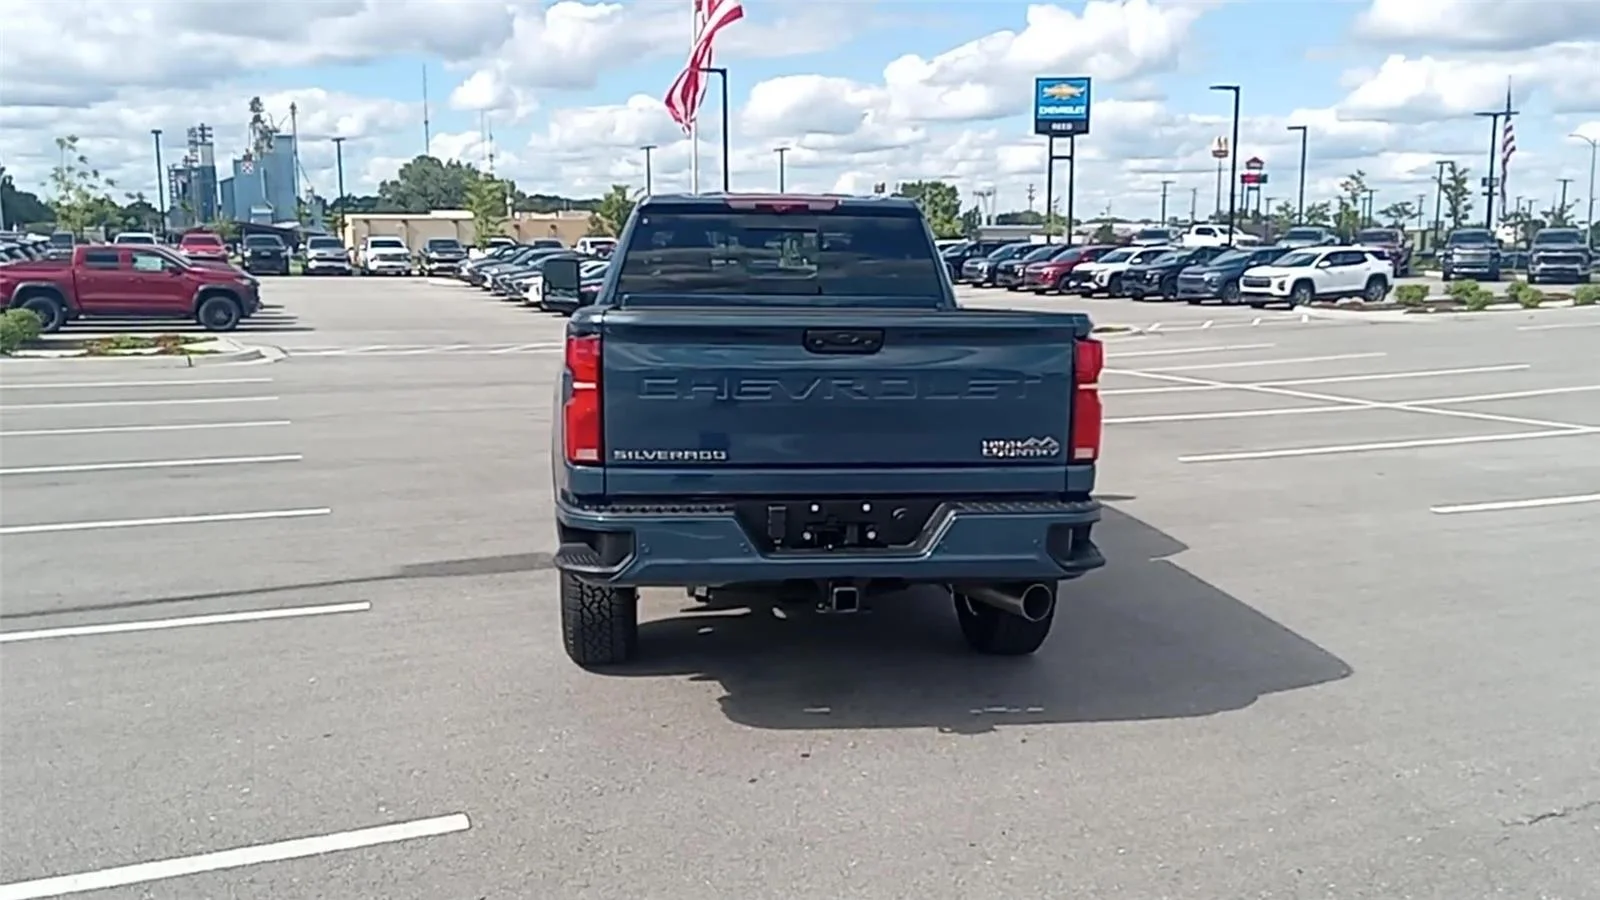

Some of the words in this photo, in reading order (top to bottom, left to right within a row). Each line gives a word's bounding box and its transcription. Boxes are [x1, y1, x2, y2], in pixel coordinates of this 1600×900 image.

[636, 377, 1043, 401] CHEVROLET
[613, 449, 728, 461] SILVERADO
[982, 448, 1060, 457] COUNTRY
